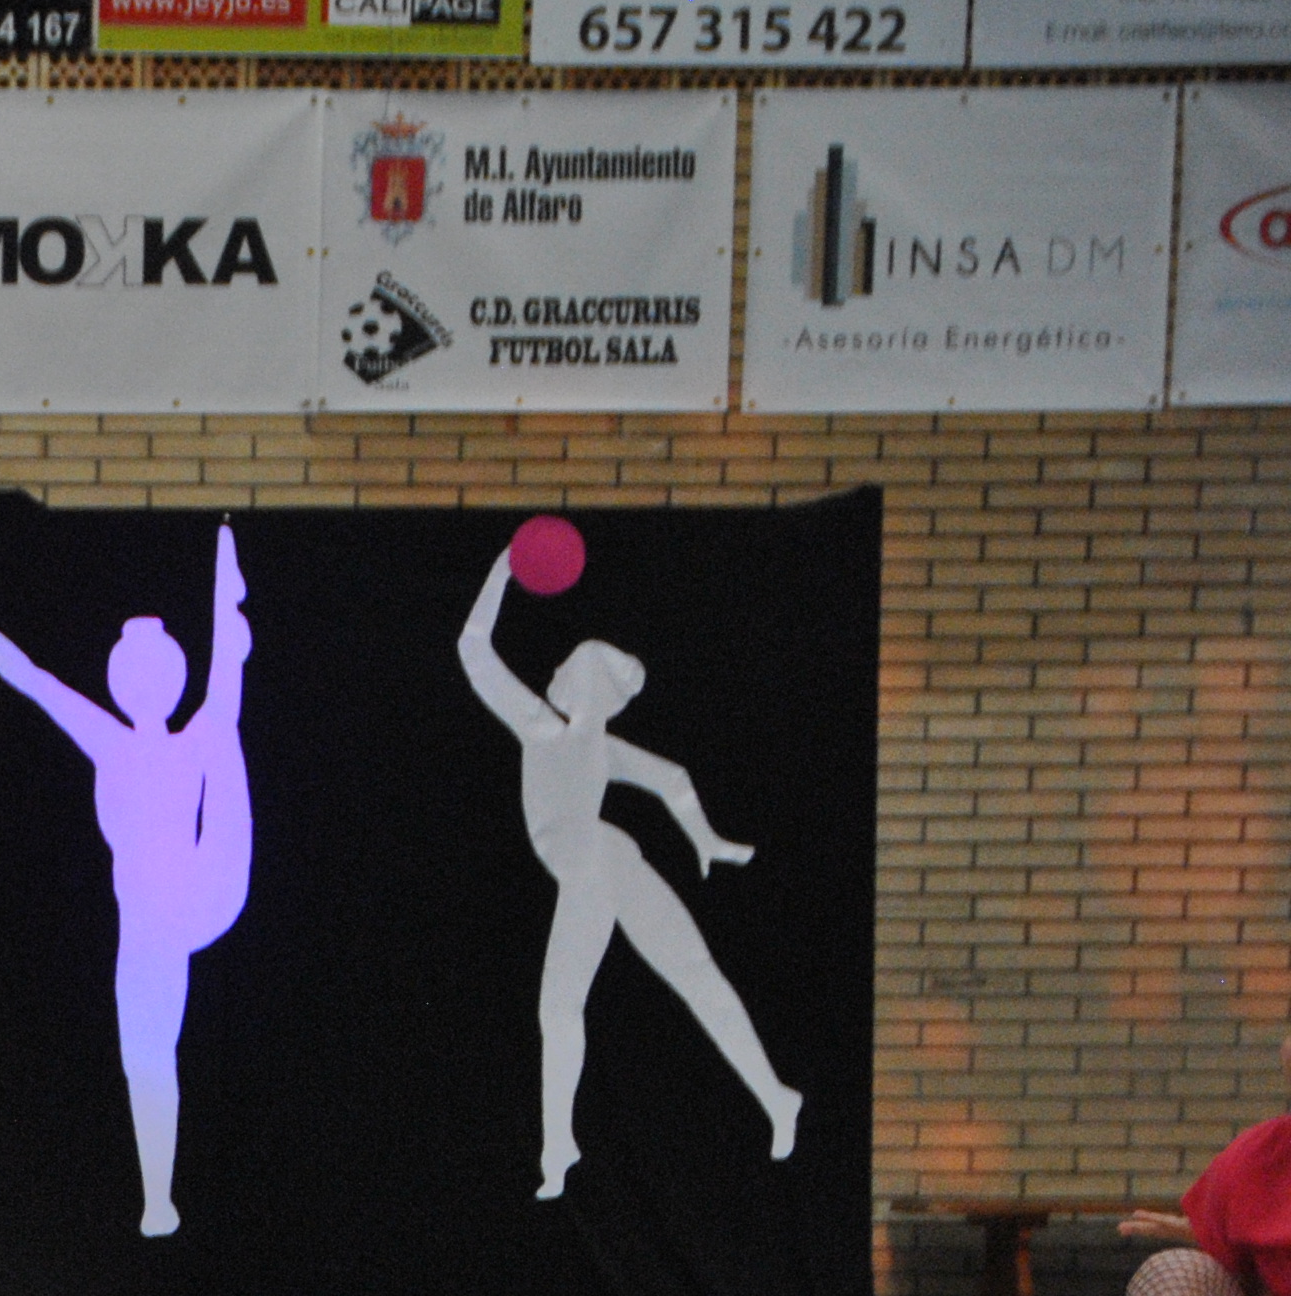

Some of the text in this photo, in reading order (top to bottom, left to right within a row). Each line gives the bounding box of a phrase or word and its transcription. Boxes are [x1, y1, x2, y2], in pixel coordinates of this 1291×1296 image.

[27, 12, 81, 44] 167
[579, 6, 906, 52] 657 315 422
[464, 145, 696, 185] M.I. Ayuntamiento
[464, 189, 583, 223] de Alfaro
[887, 236, 1125, 277] INSA DM
[470, 297, 700, 326] C.D. GRACCURRIS
[489, 335, 678, 365] FUTBOL SALA
